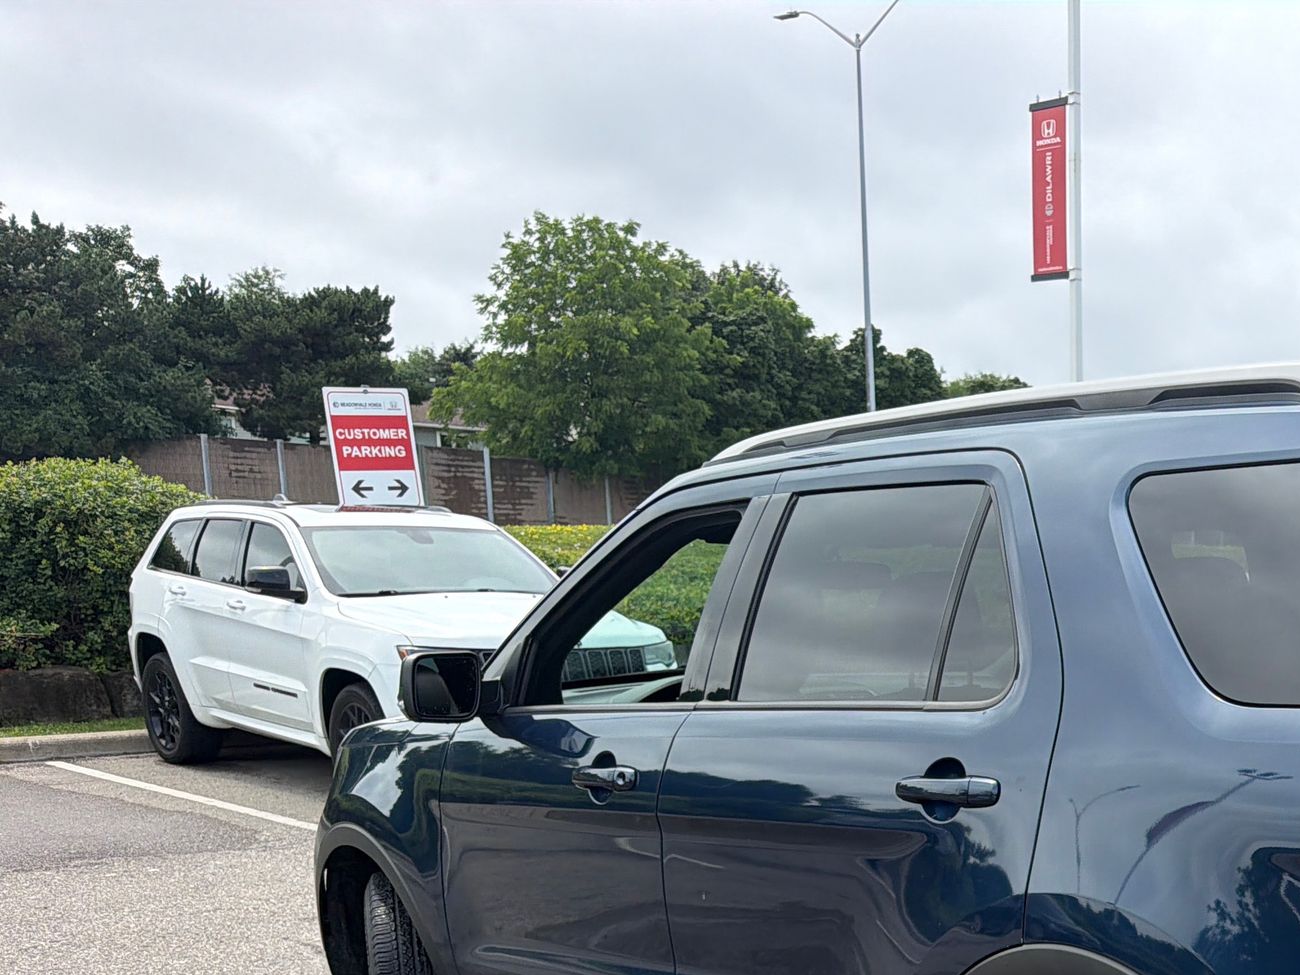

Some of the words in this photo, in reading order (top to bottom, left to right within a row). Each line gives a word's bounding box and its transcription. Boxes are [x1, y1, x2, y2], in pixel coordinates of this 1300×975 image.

[1036, 136, 1061, 147] HONDA
[1045, 151, 1054, 202] DILAWRI
[335, 428, 408, 440] CUSTOMER
[342, 445, 407, 458] PARKING
